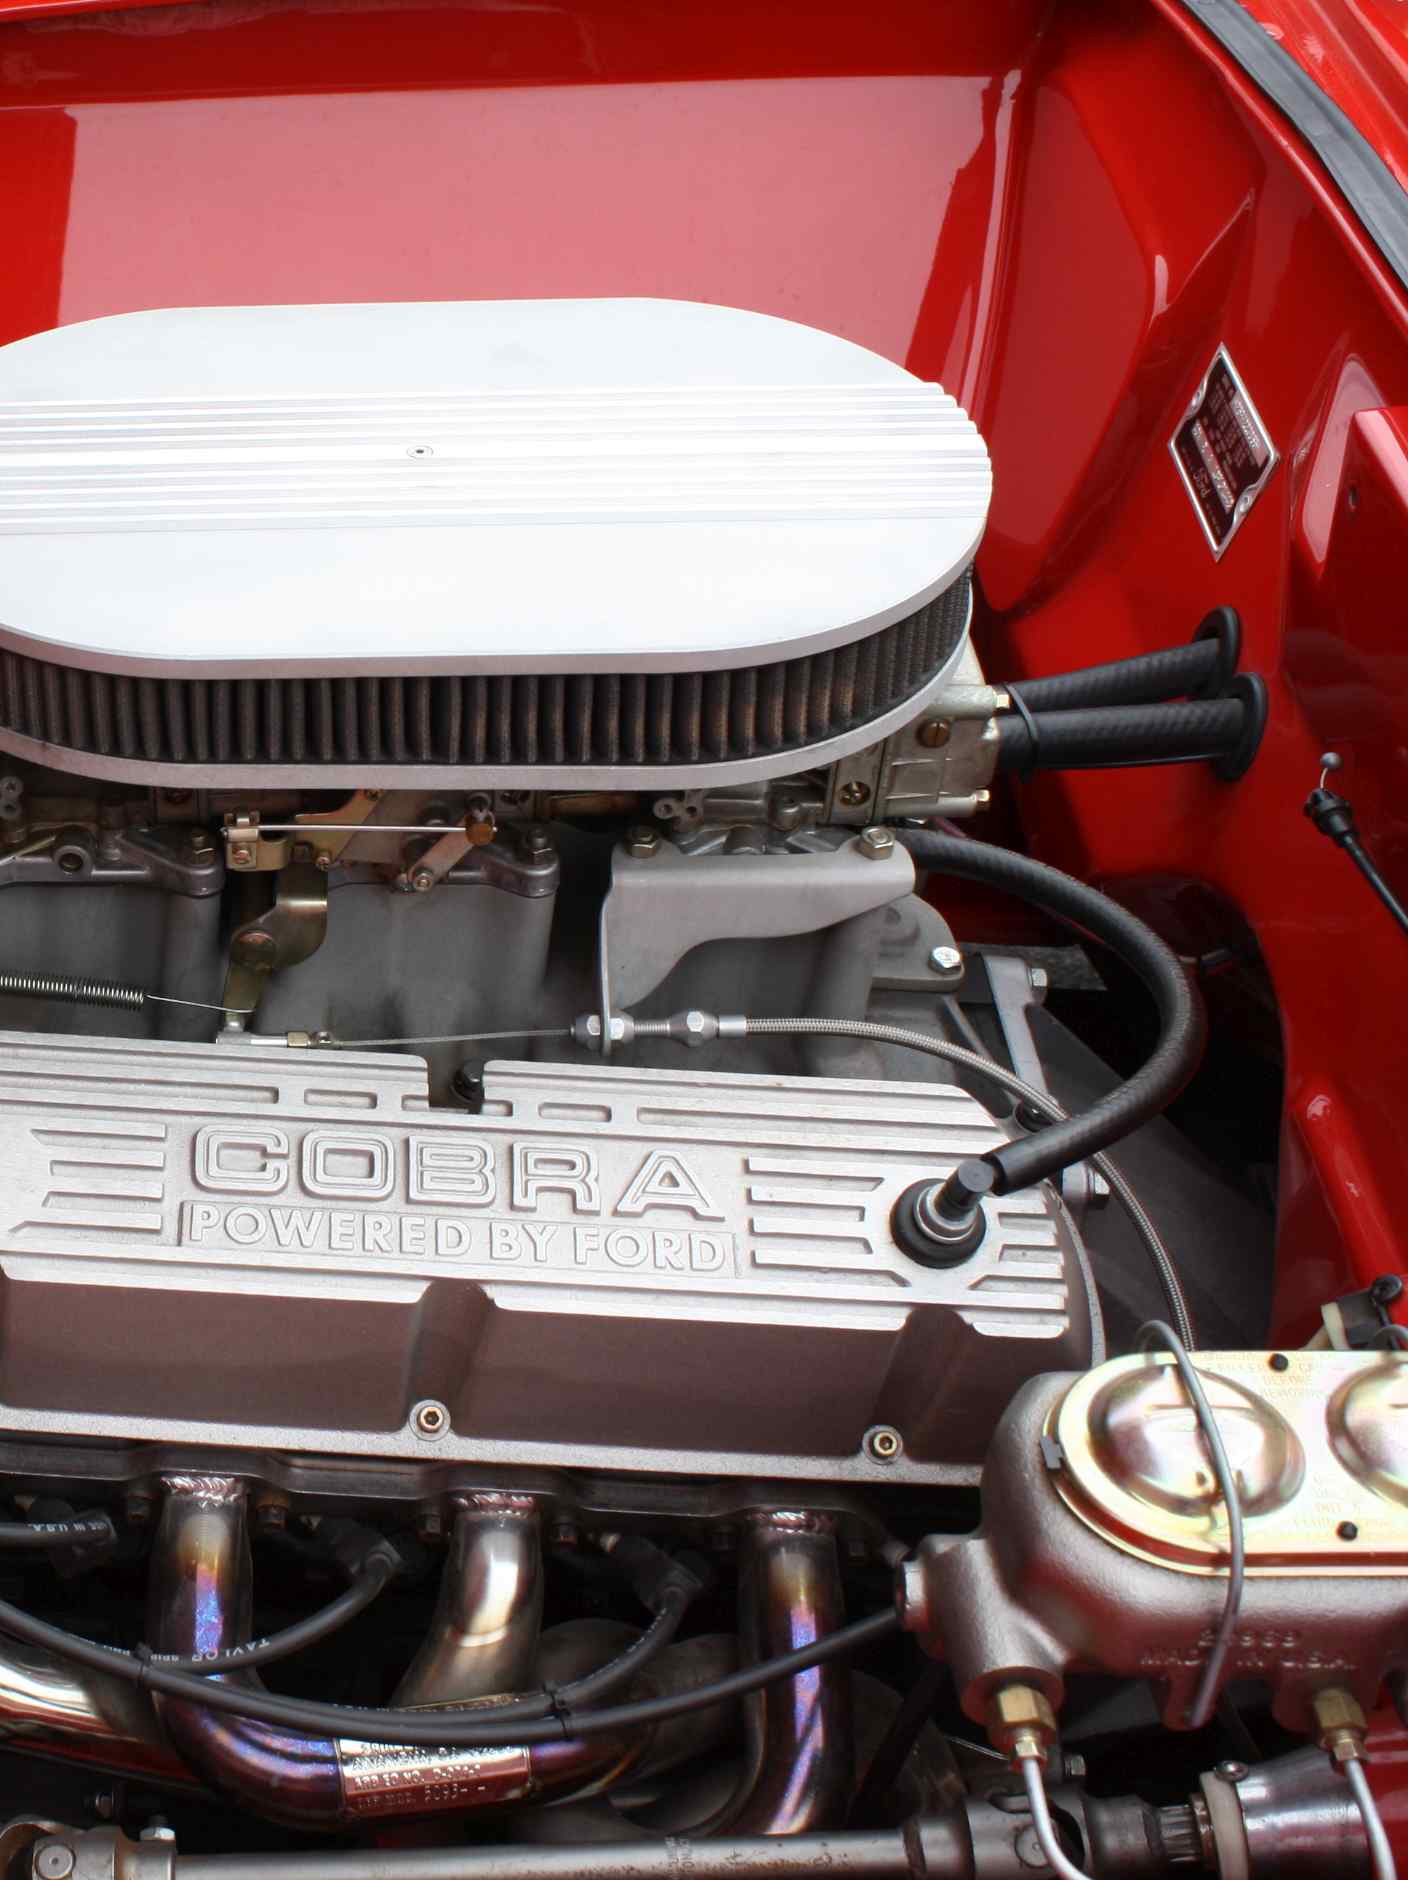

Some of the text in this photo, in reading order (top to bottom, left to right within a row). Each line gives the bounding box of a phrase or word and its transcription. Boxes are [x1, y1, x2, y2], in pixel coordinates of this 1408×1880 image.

[195, 1123, 725, 1222] COBRA
[192, 1205, 727, 1273] POWERED BY FORD
